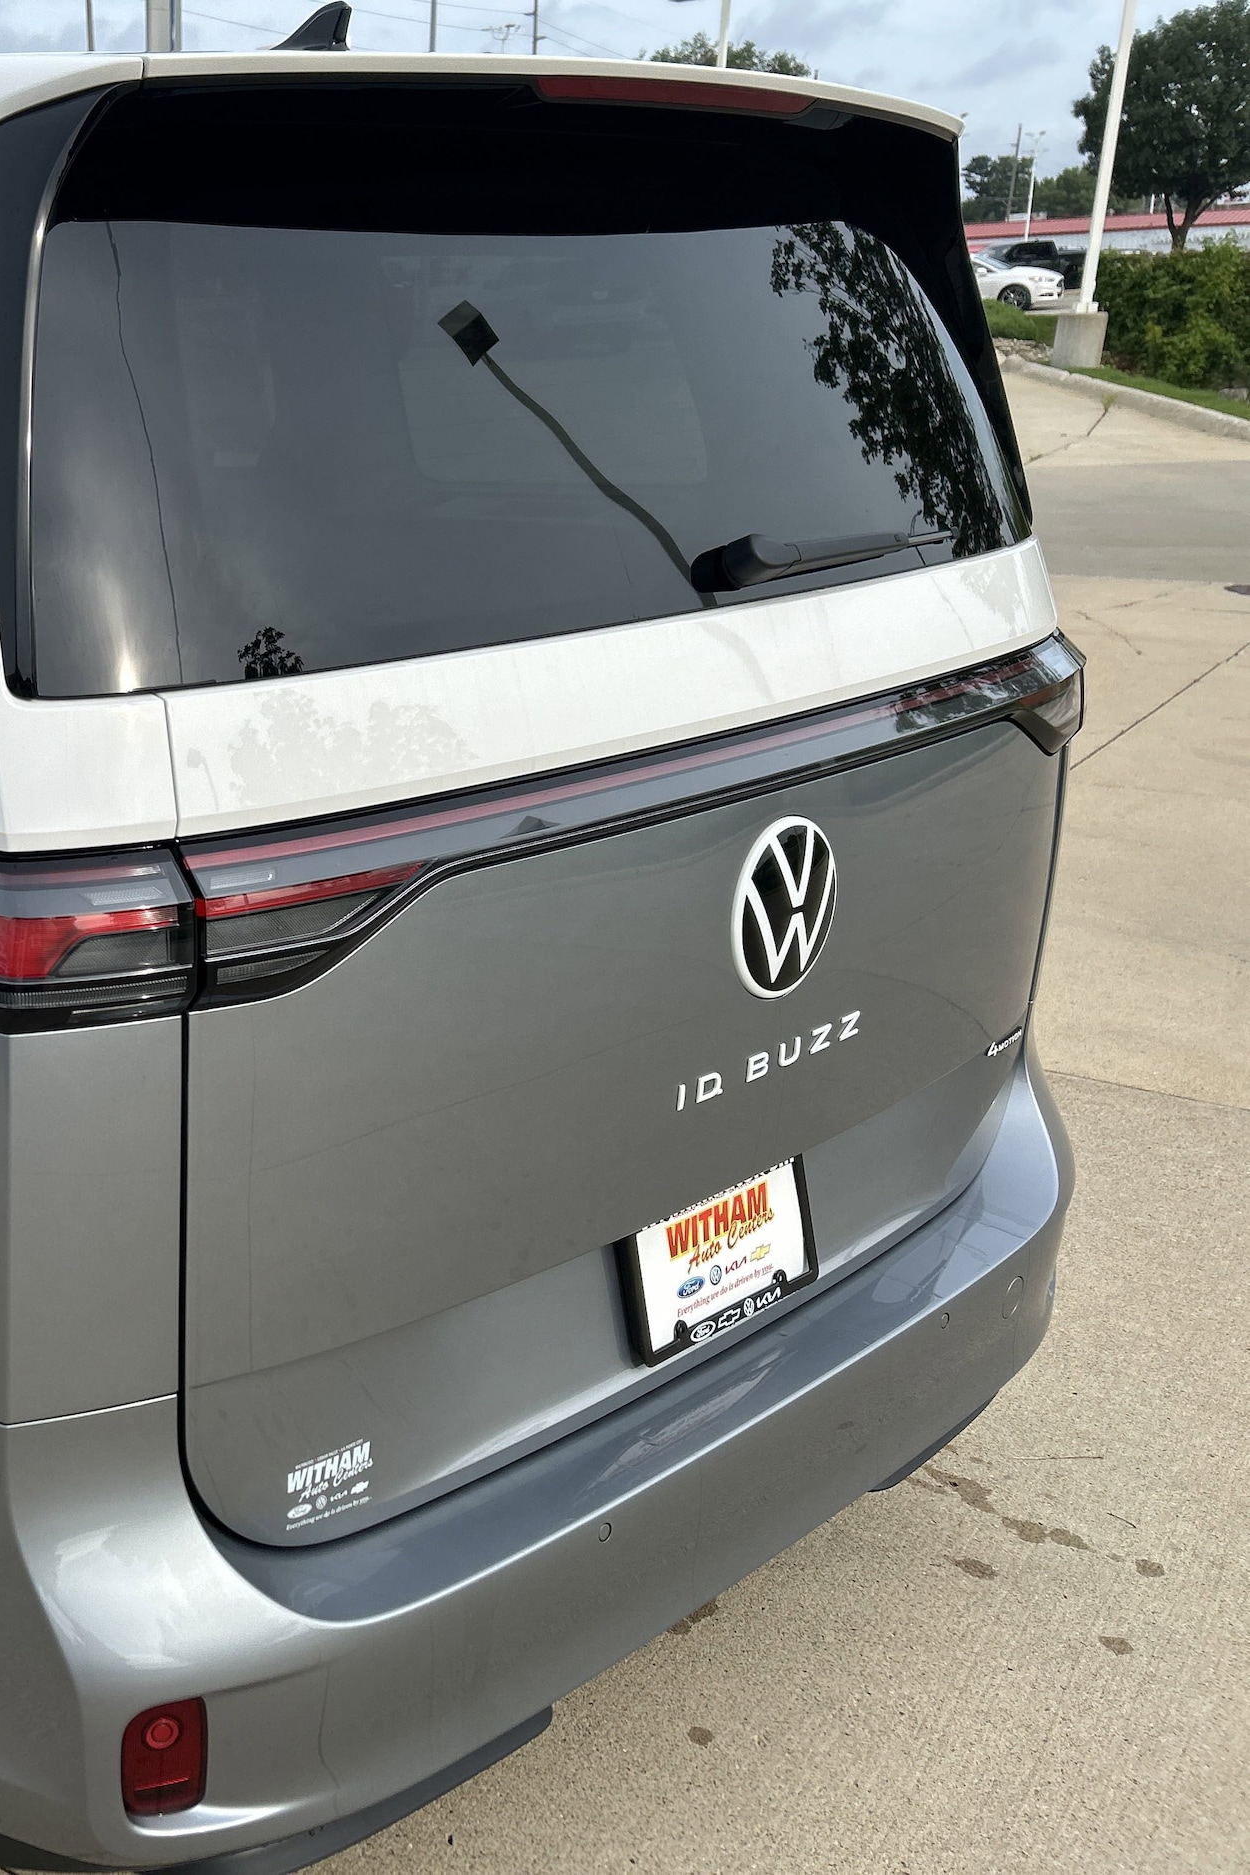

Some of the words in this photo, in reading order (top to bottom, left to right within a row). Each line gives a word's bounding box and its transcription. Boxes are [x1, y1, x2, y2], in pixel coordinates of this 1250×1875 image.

[745, 1010, 861, 1082] BUZZ
[987, 1029, 1022, 1057] 4MOTION
[665, 1182, 768, 1259] WITHAM
[688, 1243, 722, 1275] Auto
[727, 1208, 775, 1249] Centers
[677, 1294, 710, 1318] Everything
[711, 1290, 720, 1301] we
[720, 1285, 728, 1296] do
[729, 1282, 734, 1291] is
[734, 1273, 753, 1288] driven
[754, 1268, 761, 1279] by
[287, 1441, 371, 1493] WITHAM
[298, 1481, 329, 1503] Auto
